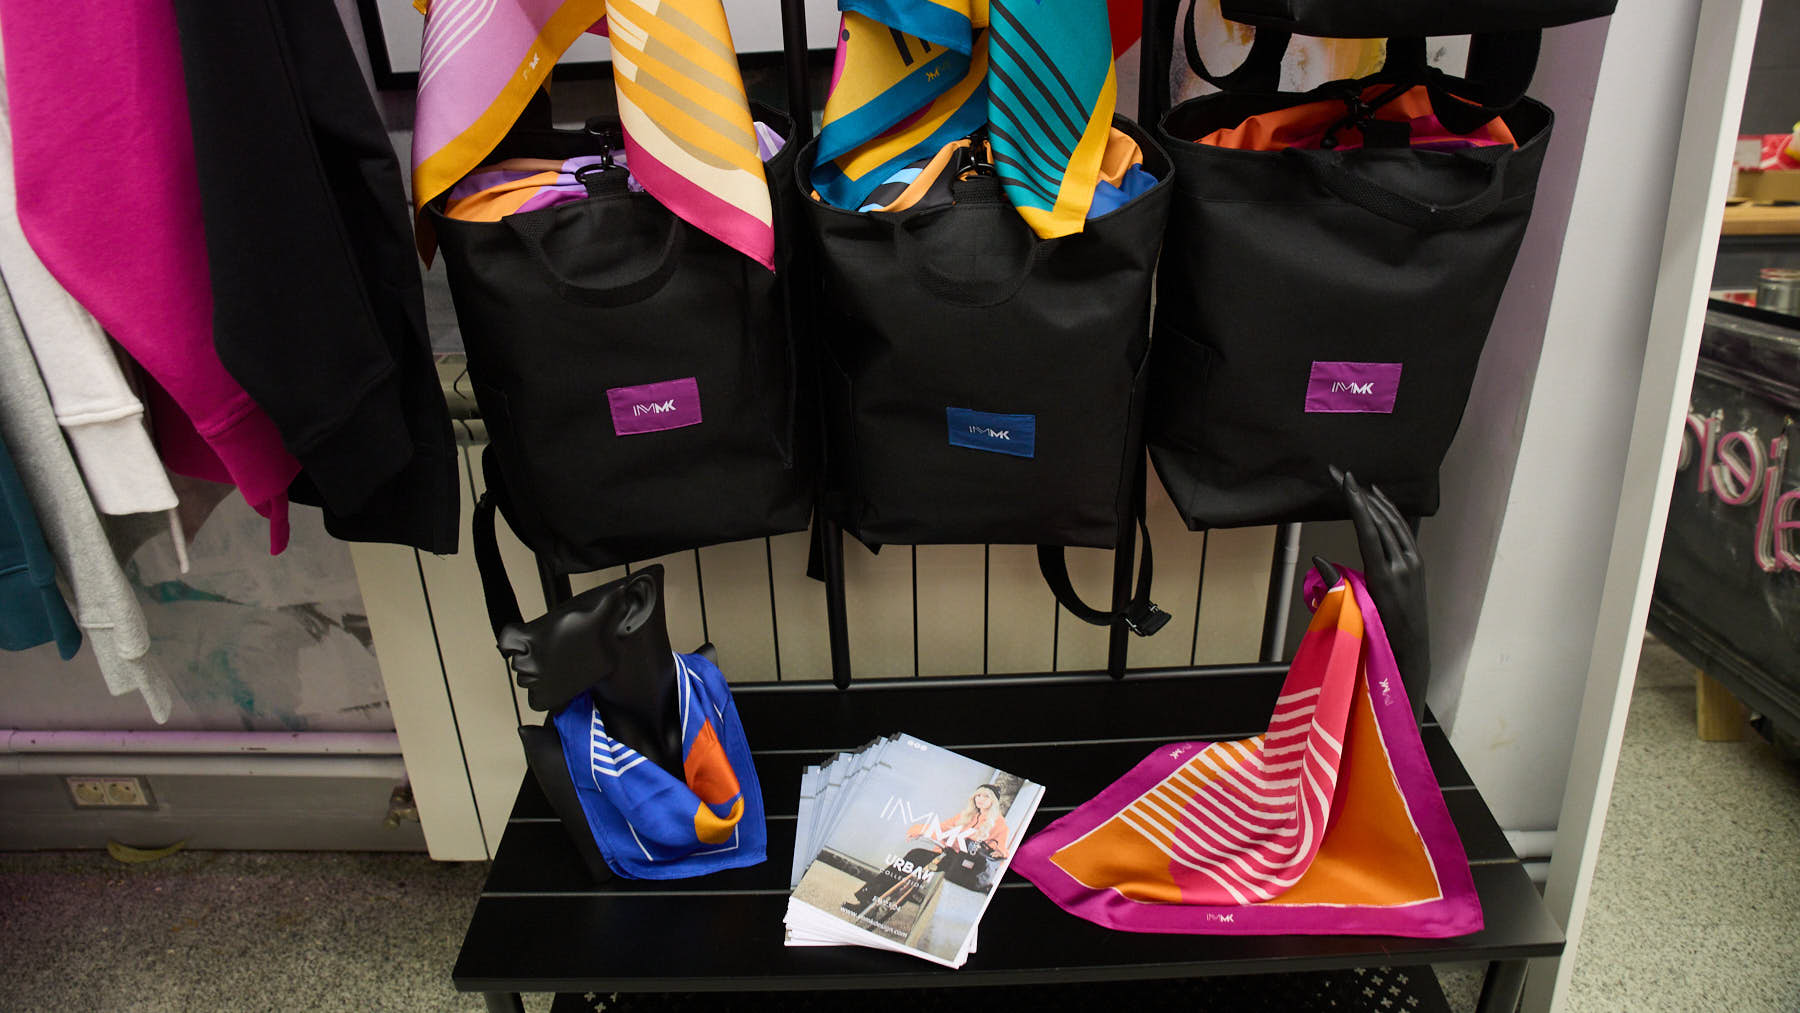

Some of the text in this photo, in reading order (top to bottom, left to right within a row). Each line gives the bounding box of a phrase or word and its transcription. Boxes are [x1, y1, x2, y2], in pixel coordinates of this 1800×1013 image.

[1331, 381, 1375, 395] IMMK
[632, 399, 677, 417] IMMK
[885, 853, 935, 884] URBAN
